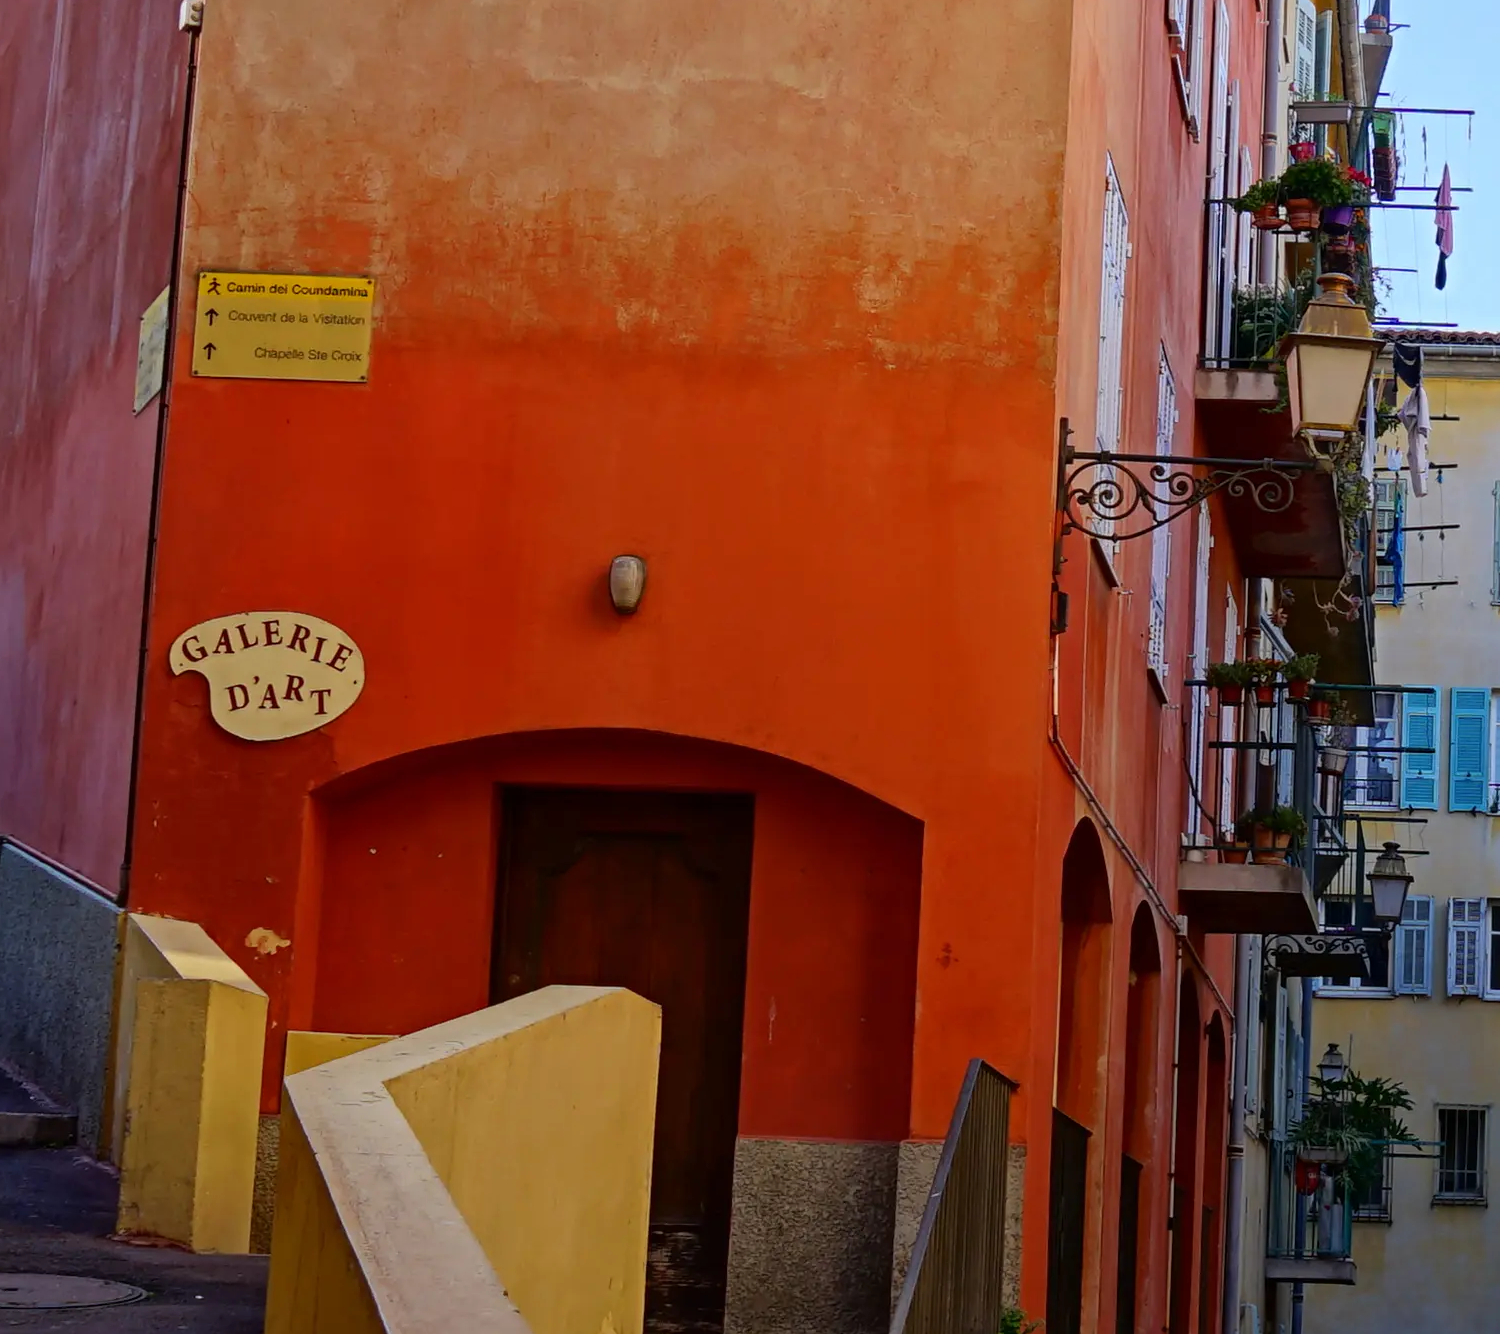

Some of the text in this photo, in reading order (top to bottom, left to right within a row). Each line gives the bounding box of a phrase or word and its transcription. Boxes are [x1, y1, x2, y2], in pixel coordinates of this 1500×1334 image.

[226, 281, 266, 294] Camin
[292, 284, 368, 298] Coundamina
[228, 310, 366, 326] Couvent de la Visitation
[254, 346, 363, 362] Chapelle Ste Croix
[181, 619, 354, 673] GALERIE
[225, 674, 332, 717] D'ART
